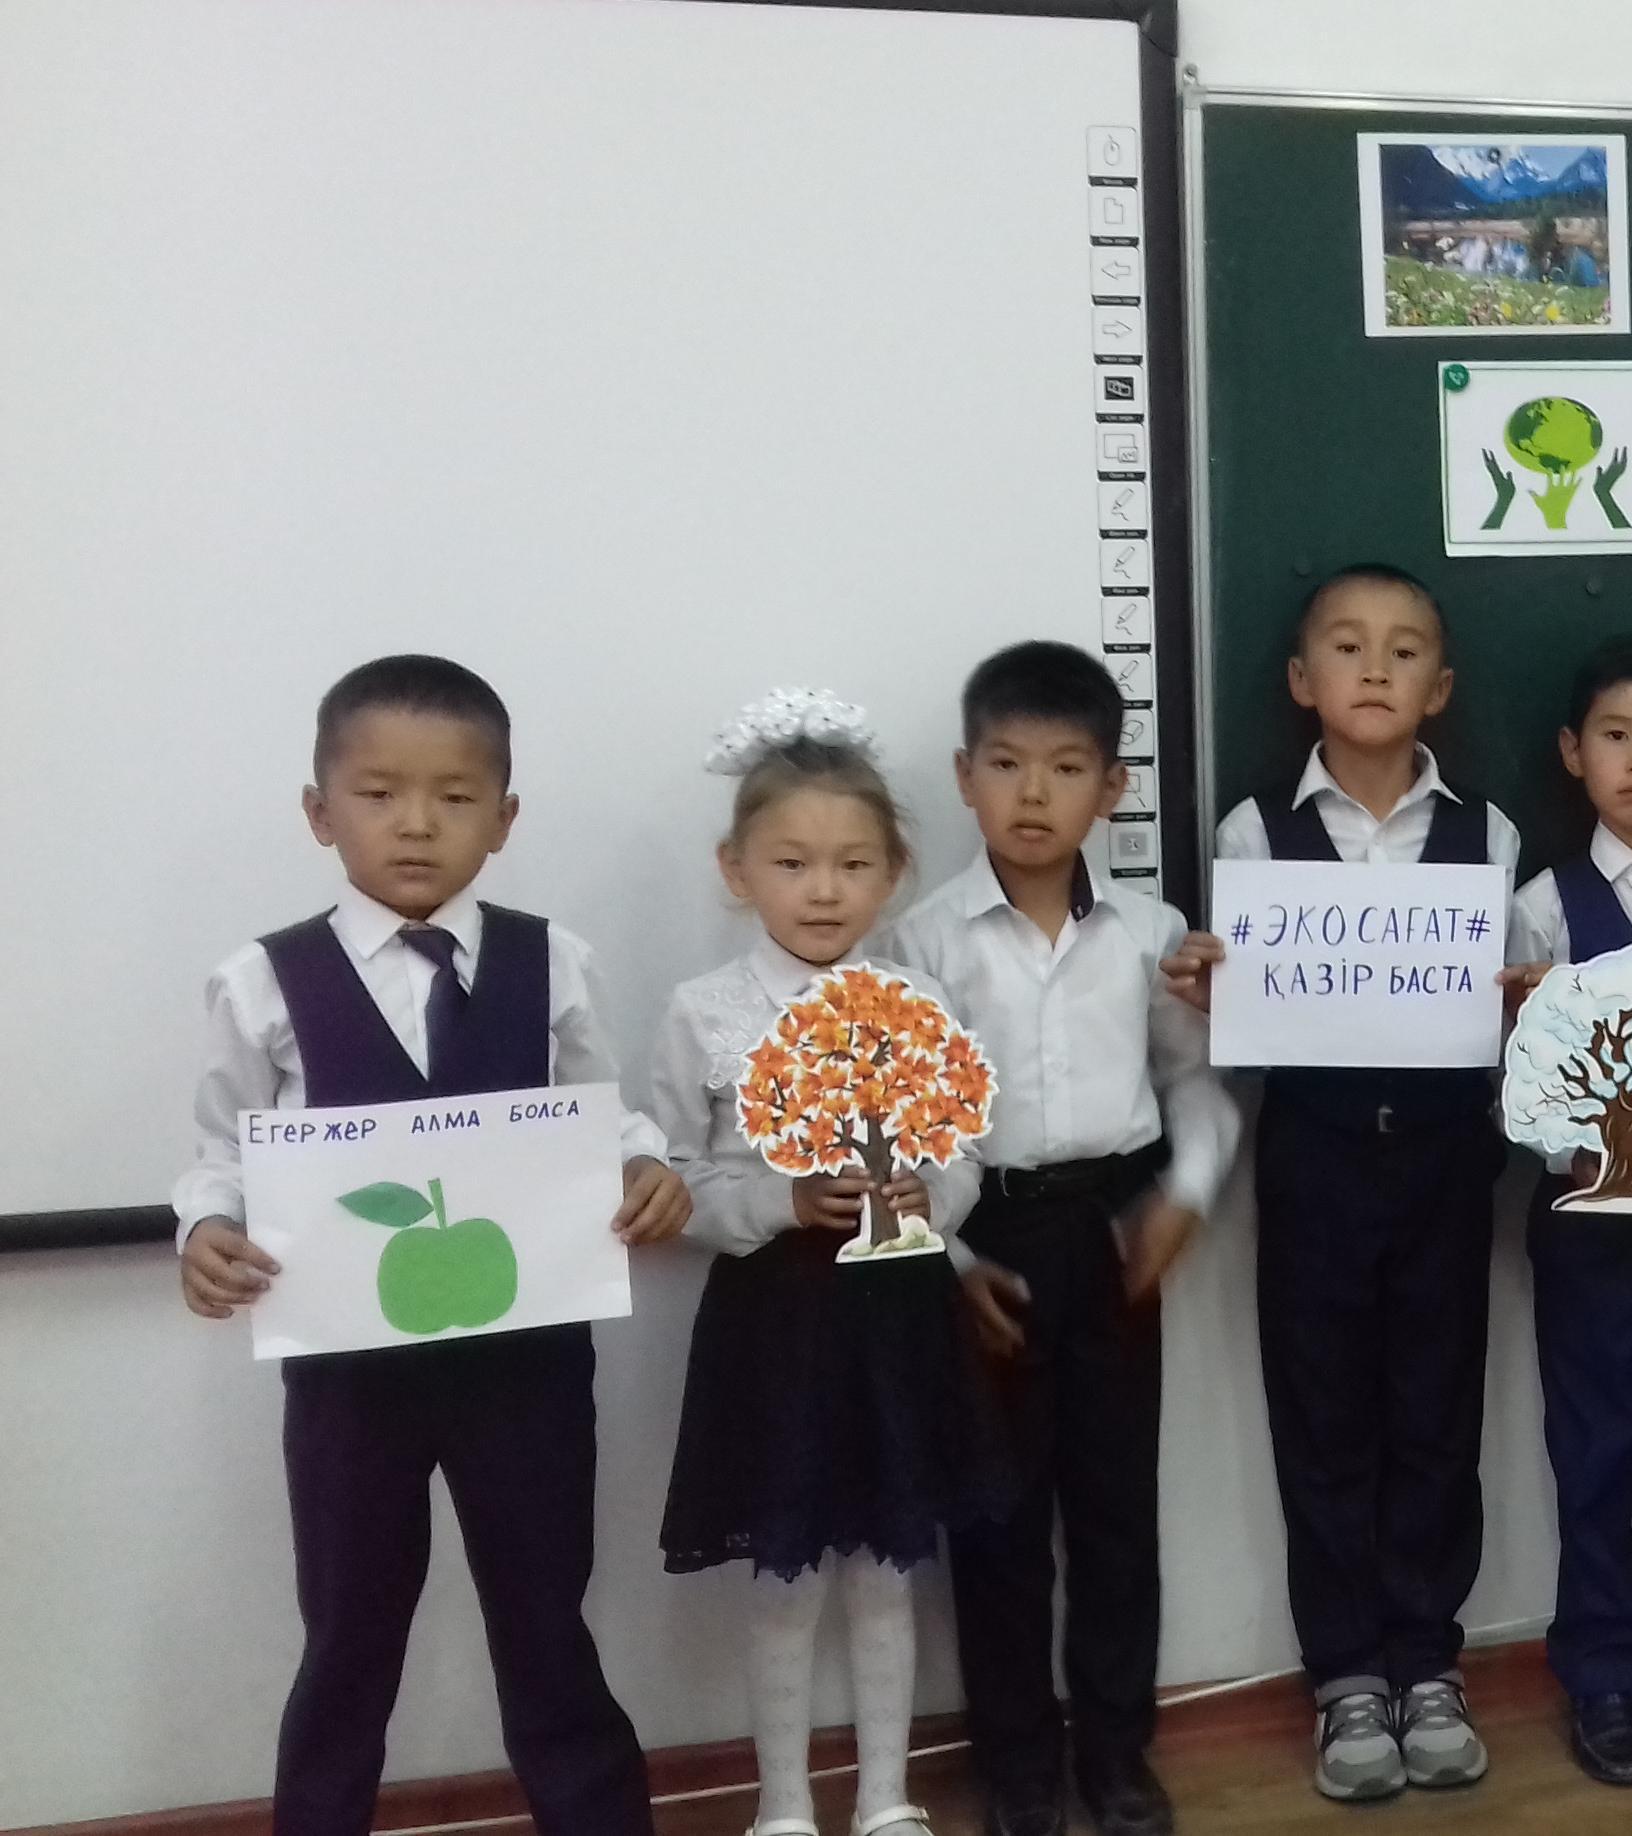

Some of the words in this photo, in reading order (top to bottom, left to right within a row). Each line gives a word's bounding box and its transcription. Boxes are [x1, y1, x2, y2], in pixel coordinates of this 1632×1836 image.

[1264, 958, 1374, 1000] ҚАЗІР
[1389, 965, 1473, 995] БАСТА
[411, 1109, 481, 1134] АЛМА
[509, 1100, 580, 1123] БОЛСА
